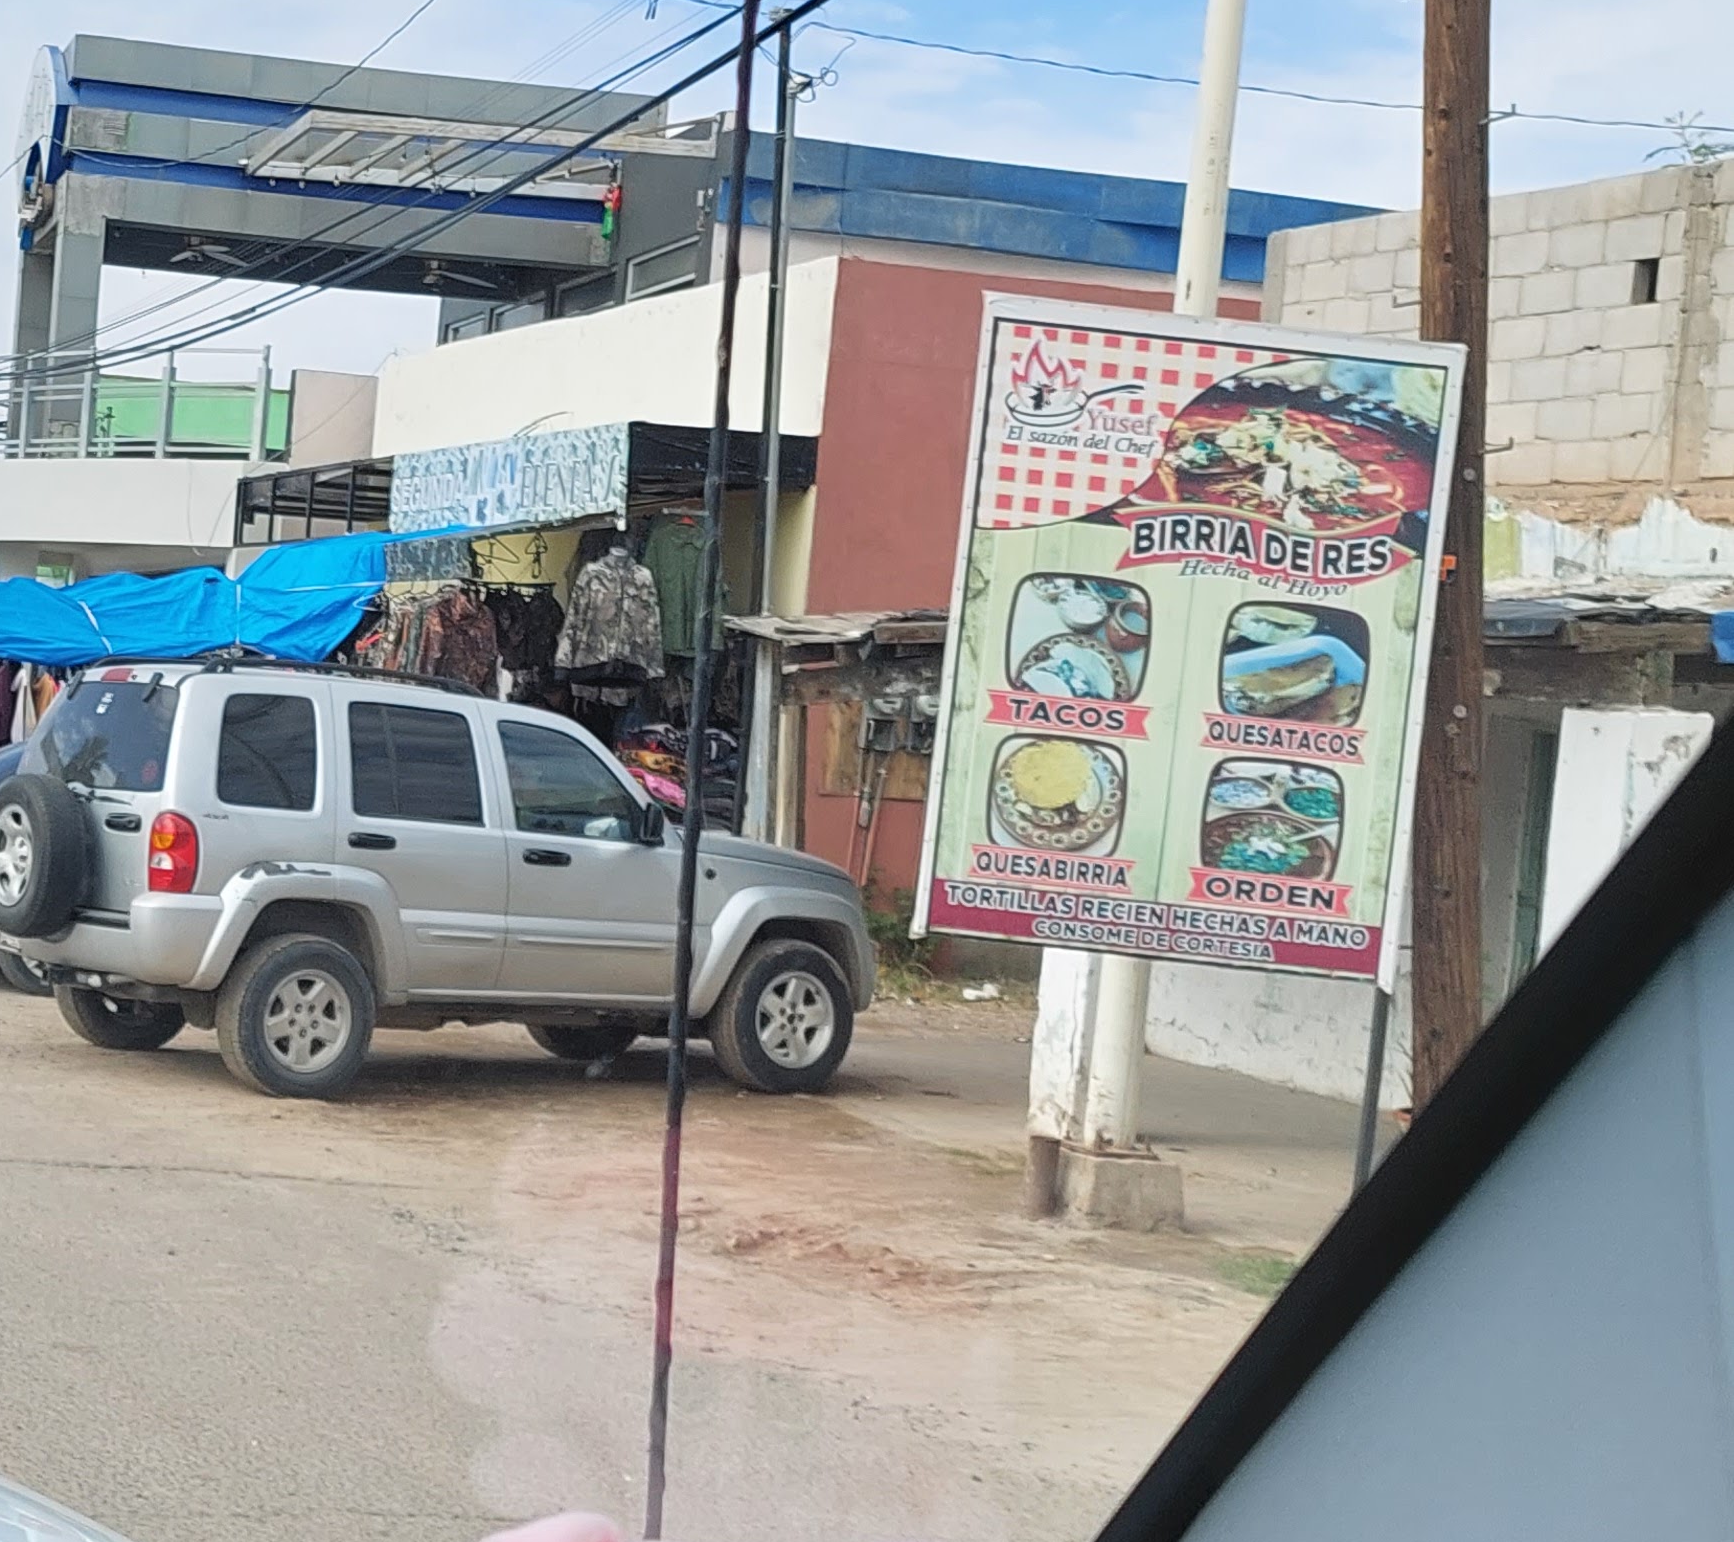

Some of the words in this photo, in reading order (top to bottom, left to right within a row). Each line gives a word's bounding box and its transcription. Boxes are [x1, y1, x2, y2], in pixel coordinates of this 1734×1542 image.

[1006, 425, 1023, 440] El
[1027, 429, 1078, 447] sazón
[1083, 433, 1111, 451] del
[1115, 436, 1157, 458] Chef
[1087, 409, 1158, 437] Yusef
[391, 471, 466, 511] SEGUNDA
[1132, 518, 1253, 560] BIRRIA
[1265, 532, 1313, 574] DE
[1321, 536, 1392, 576] RES
[1178, 559, 1251, 581] Hecha
[1257, 574, 1280, 590] al
[1286, 579, 1348, 601] Hoyo
[1008, 698, 1126, 732] TACOS
[1208, 720, 1360, 758] QUESATACOS
[975, 851, 1128, 888] QUESABIRRIA
[1205, 876, 1336, 911] ORDEN
[947, 884, 1074, 916] TORTILLAS
[1082, 899, 1166, 926] RECIEN
[1174, 909, 1266, 939] HECHAS
[1271, 919, 1291, 941] A
[1296, 923, 1368, 950] MANO
[1034, 919, 1138, 947] CONSOME
[1140, 932, 1168, 950] DE
[1174, 937, 1274, 960] CORTESIA
